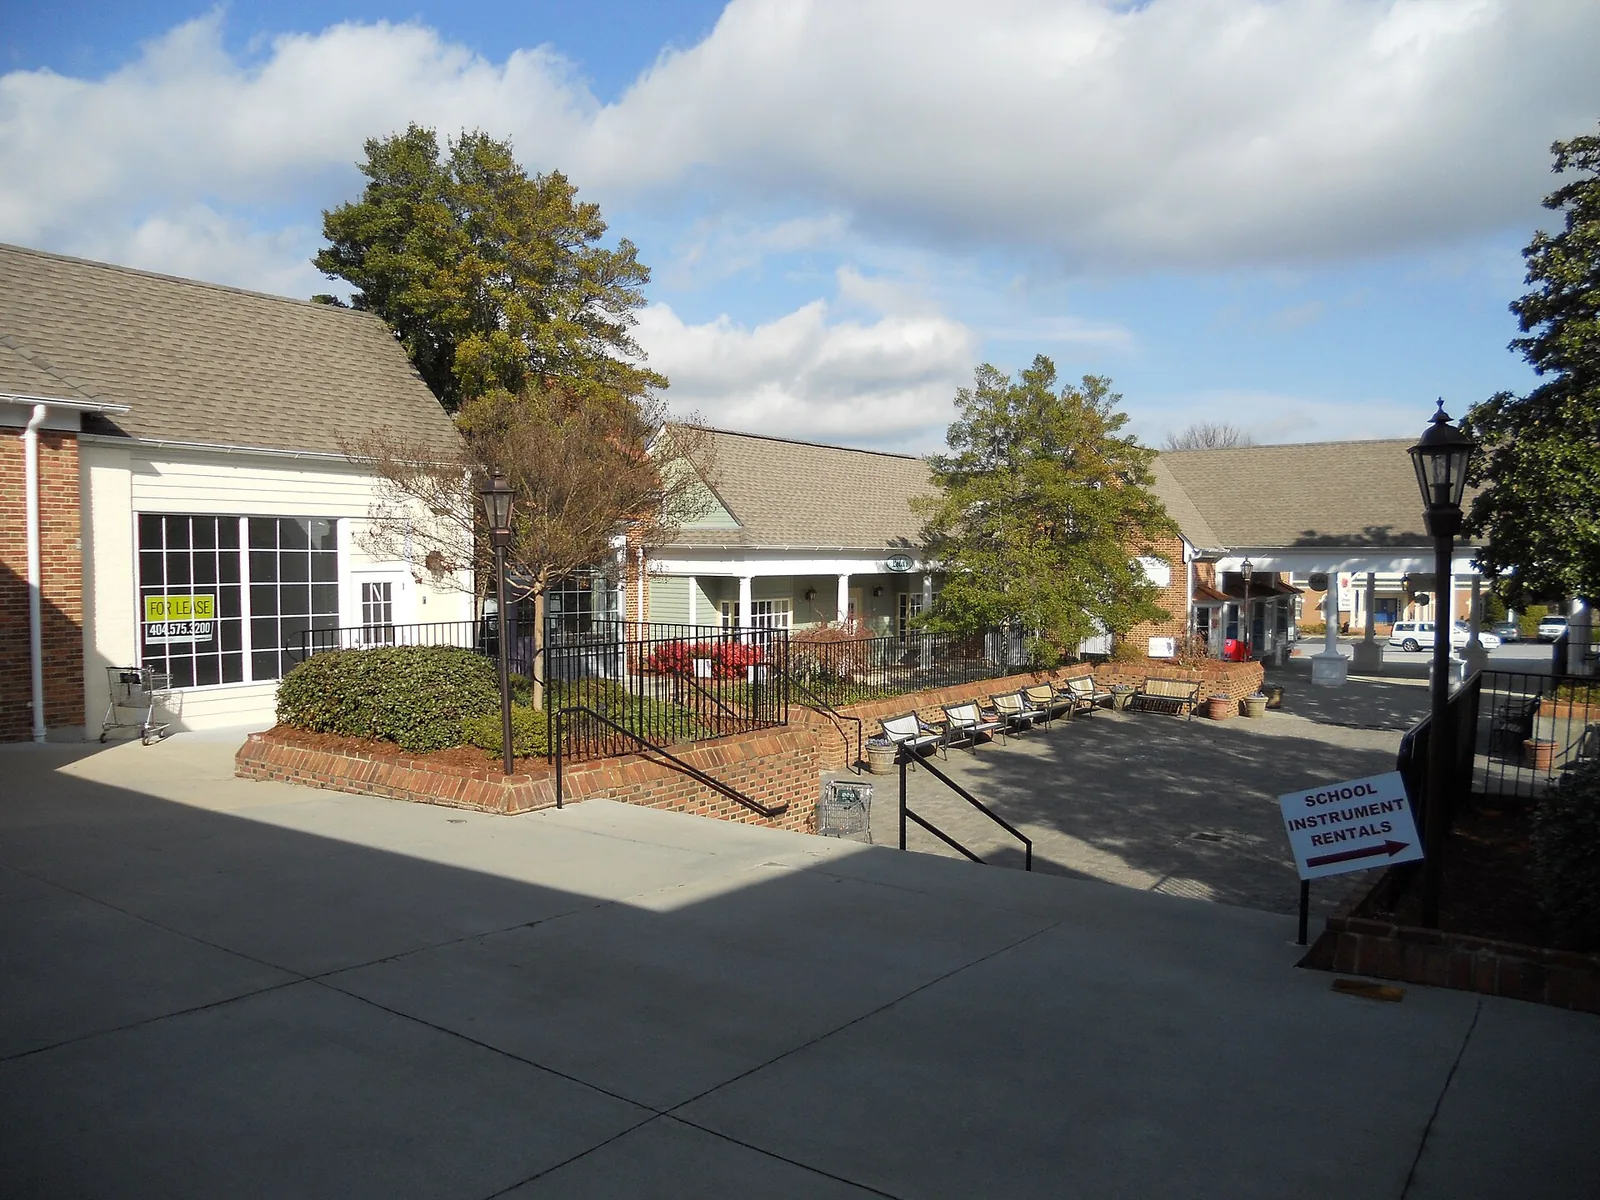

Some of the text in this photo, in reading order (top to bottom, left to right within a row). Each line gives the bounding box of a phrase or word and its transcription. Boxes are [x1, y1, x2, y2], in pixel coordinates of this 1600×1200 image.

[150, 600, 210, 616] FOR LEASE
[1304, 783, 1378, 807] SCHOOL
[1287, 798, 1404, 832] INSTRUMENT
[1310, 821, 1392, 847] RENTALS
